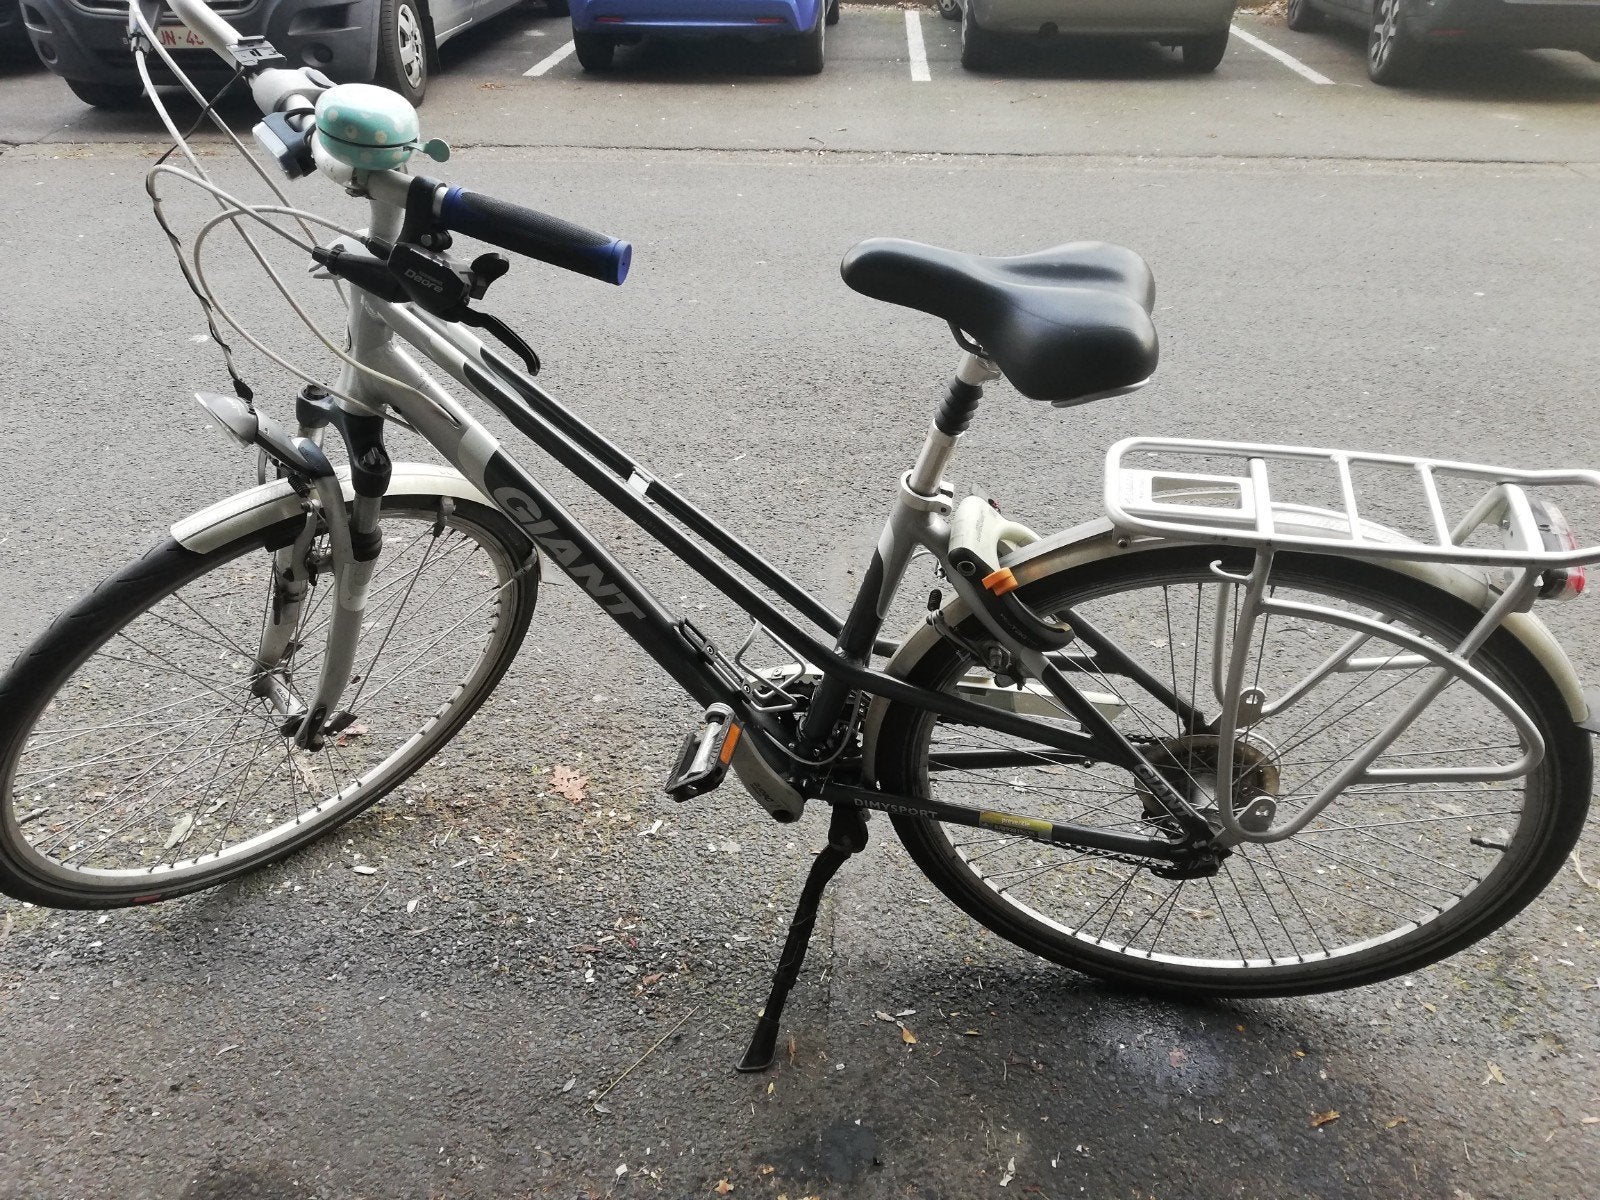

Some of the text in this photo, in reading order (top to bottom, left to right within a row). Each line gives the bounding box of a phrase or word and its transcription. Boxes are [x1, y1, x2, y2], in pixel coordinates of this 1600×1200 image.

[404, 268, 444, 294] Deore
[493, 486, 647, 620] GIANT
[854, 798, 939, 820] DIMYSPORT
